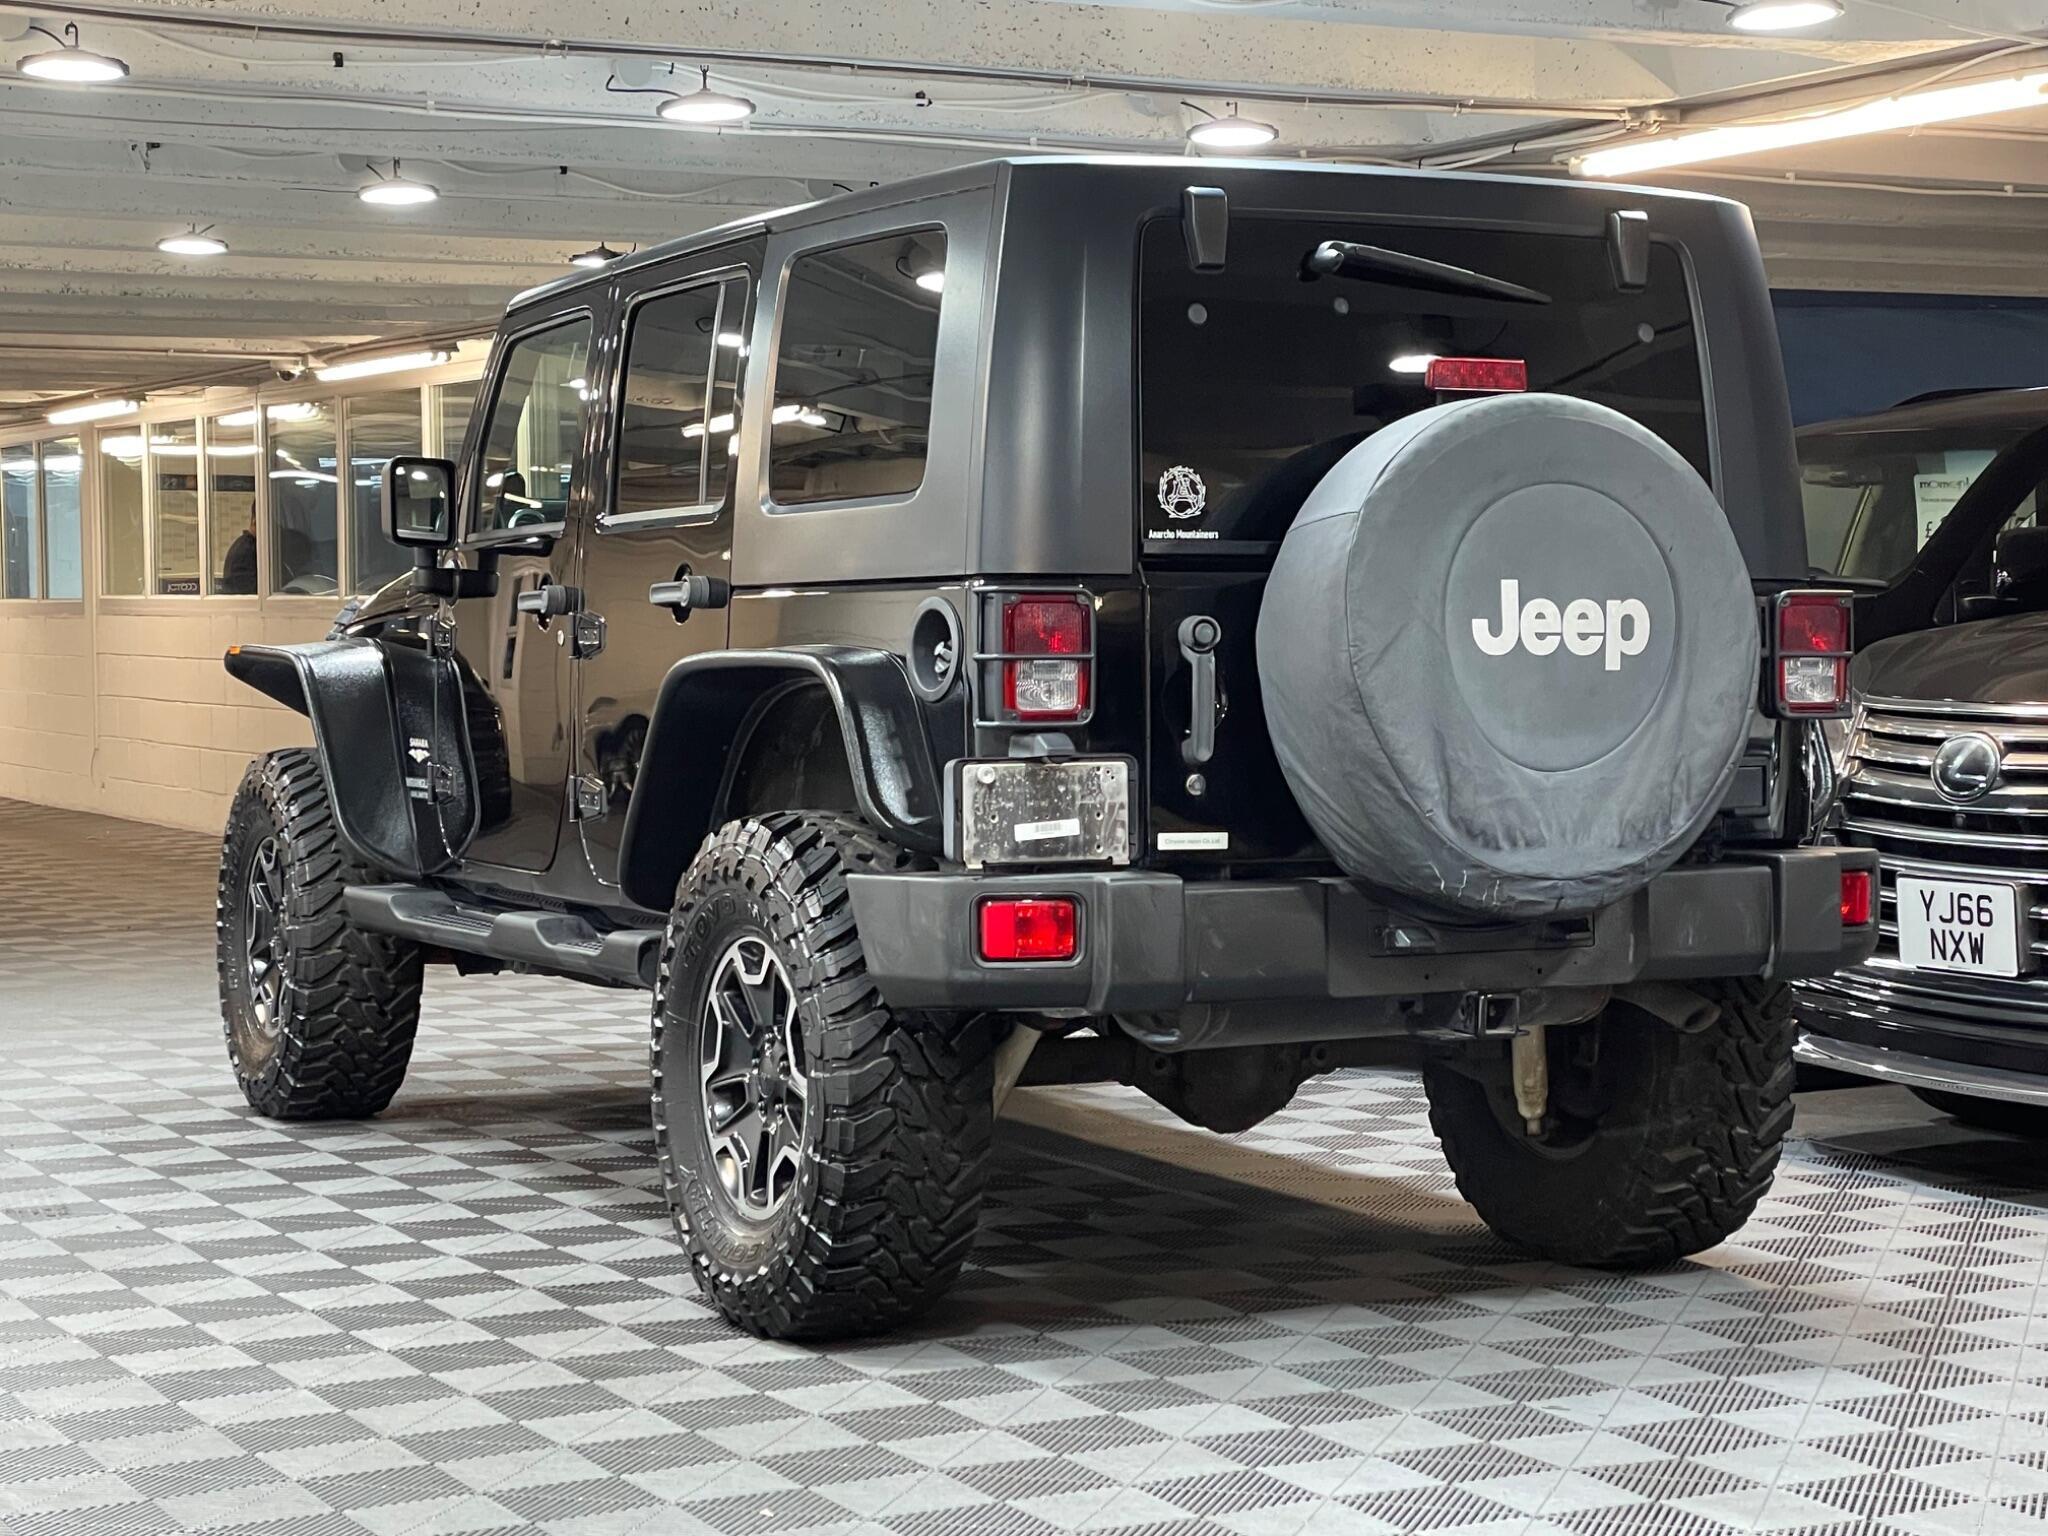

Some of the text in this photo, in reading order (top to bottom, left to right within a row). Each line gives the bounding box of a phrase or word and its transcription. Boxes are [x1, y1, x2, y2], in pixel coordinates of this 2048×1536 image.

[1148, 528, 1219, 539] Anarcho Mountaineers
[1472, 579, 1650, 670] Jeep
[1920, 889, 1993, 927] YJ66
[1930, 928, 1984, 964] NXW
